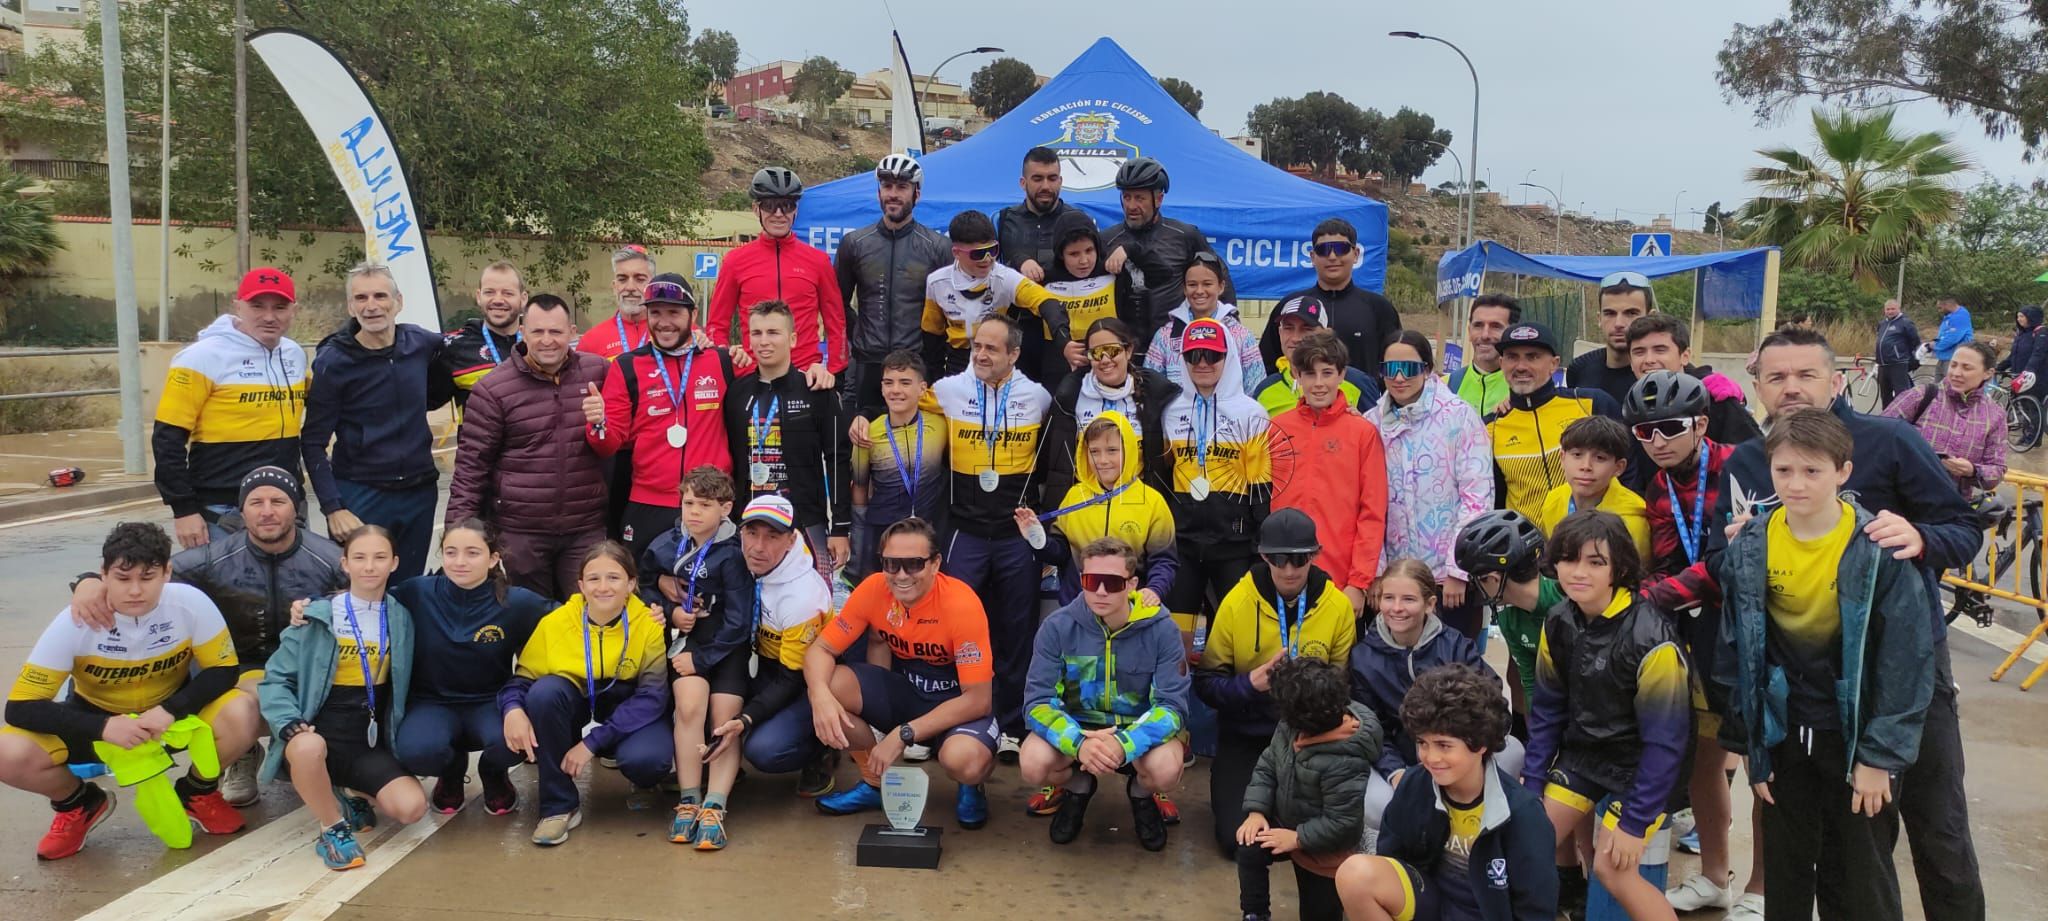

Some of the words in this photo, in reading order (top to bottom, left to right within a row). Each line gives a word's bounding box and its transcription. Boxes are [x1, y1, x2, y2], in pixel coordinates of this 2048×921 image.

[1095, 99, 1110, 107] DE
[1111, 102, 1153, 125] CICLISMO
[703, 255, 717, 272] P
[239, 390, 287, 403] RUTEROS
[878, 629, 909, 653] DON
[84, 663, 150, 679] RUTEROS
[151, 646, 190, 673] BIKES
